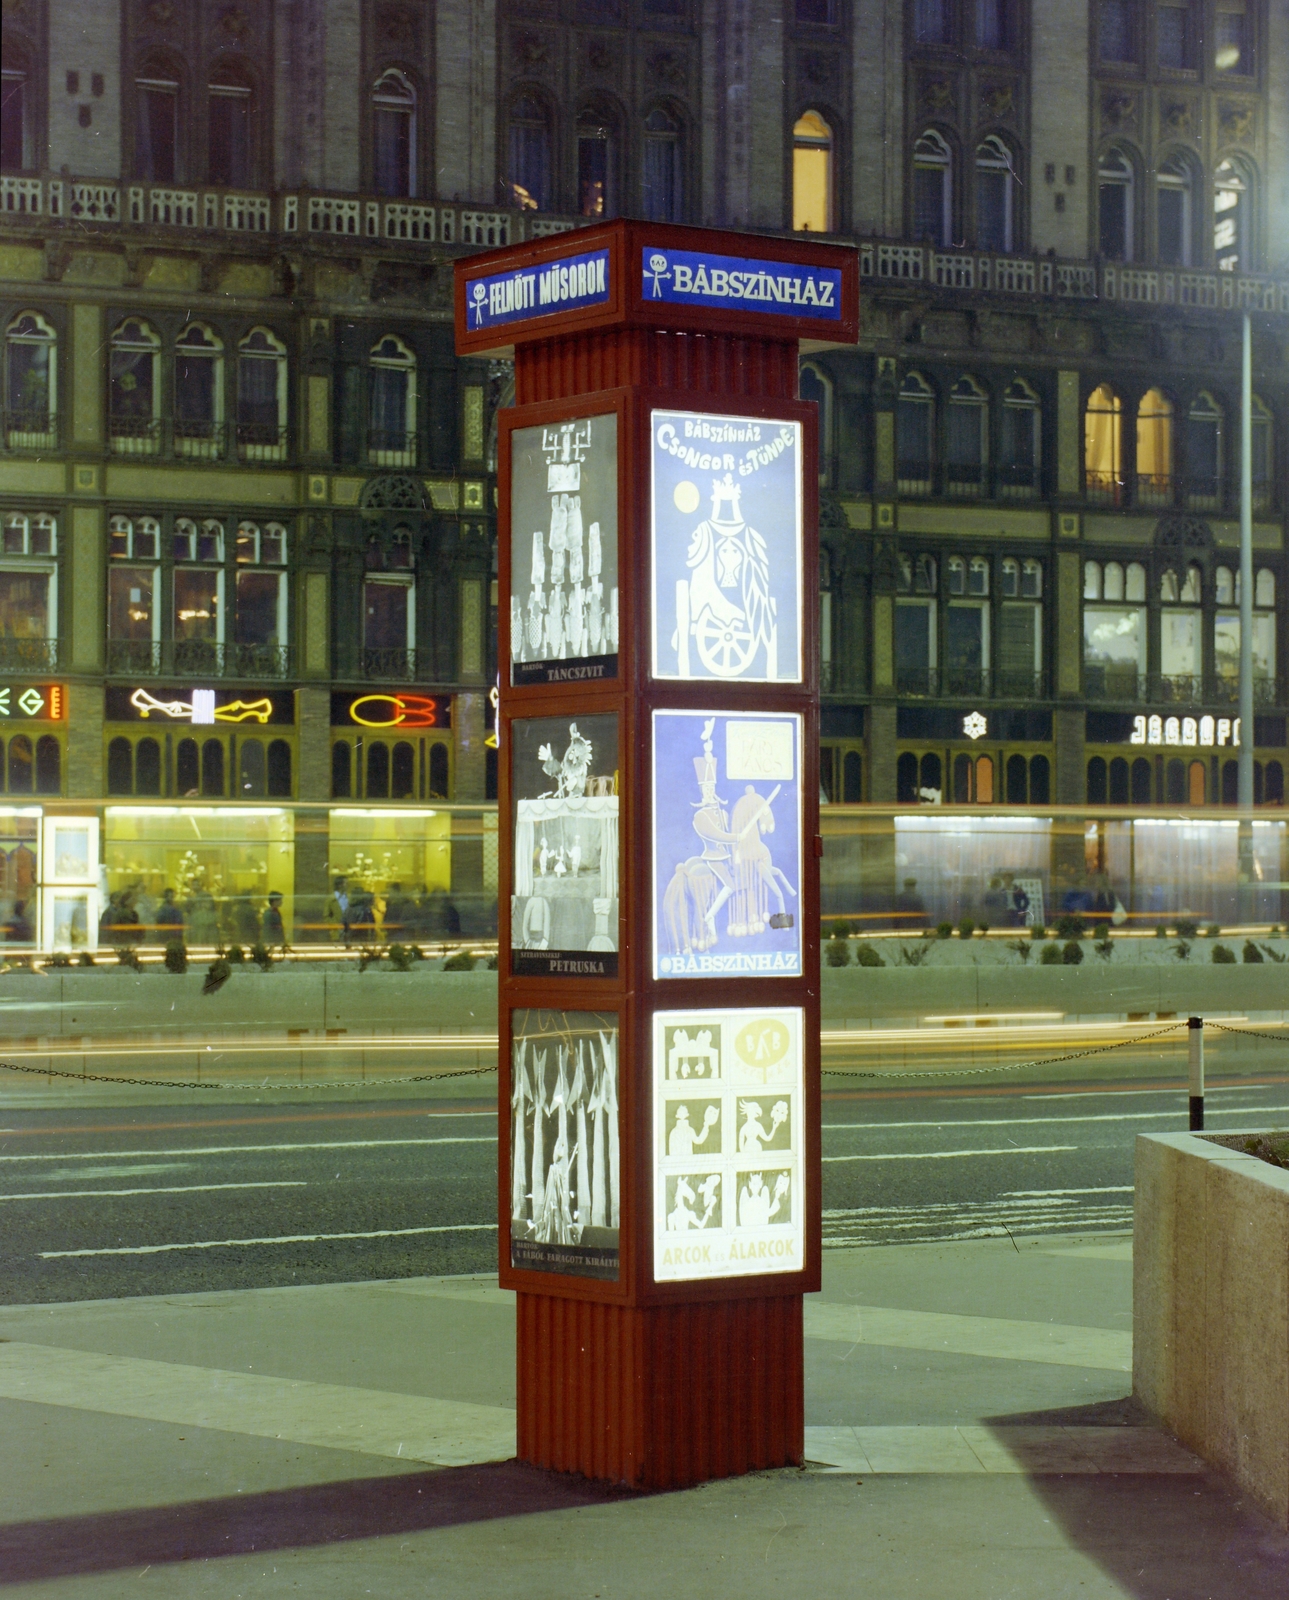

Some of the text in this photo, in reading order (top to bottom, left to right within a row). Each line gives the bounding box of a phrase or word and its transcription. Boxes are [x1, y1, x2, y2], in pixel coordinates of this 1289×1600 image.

[539, 258, 606, 306] MŰSOROK
[672, 263, 835, 307] BÁBSZÍNHÁZ
[684, 419, 761, 443] BÁBSZÍNHÁZ
[547, 664, 605, 681] TÁNCSZVIT
[549, 959, 605, 974] PETRUSKA
[671, 951, 799, 974] BÁBSZÍNHÁZ
[662, 1245, 711, 1266] ARCOK
[728, 1238, 795, 1261] ÁLARCOK
